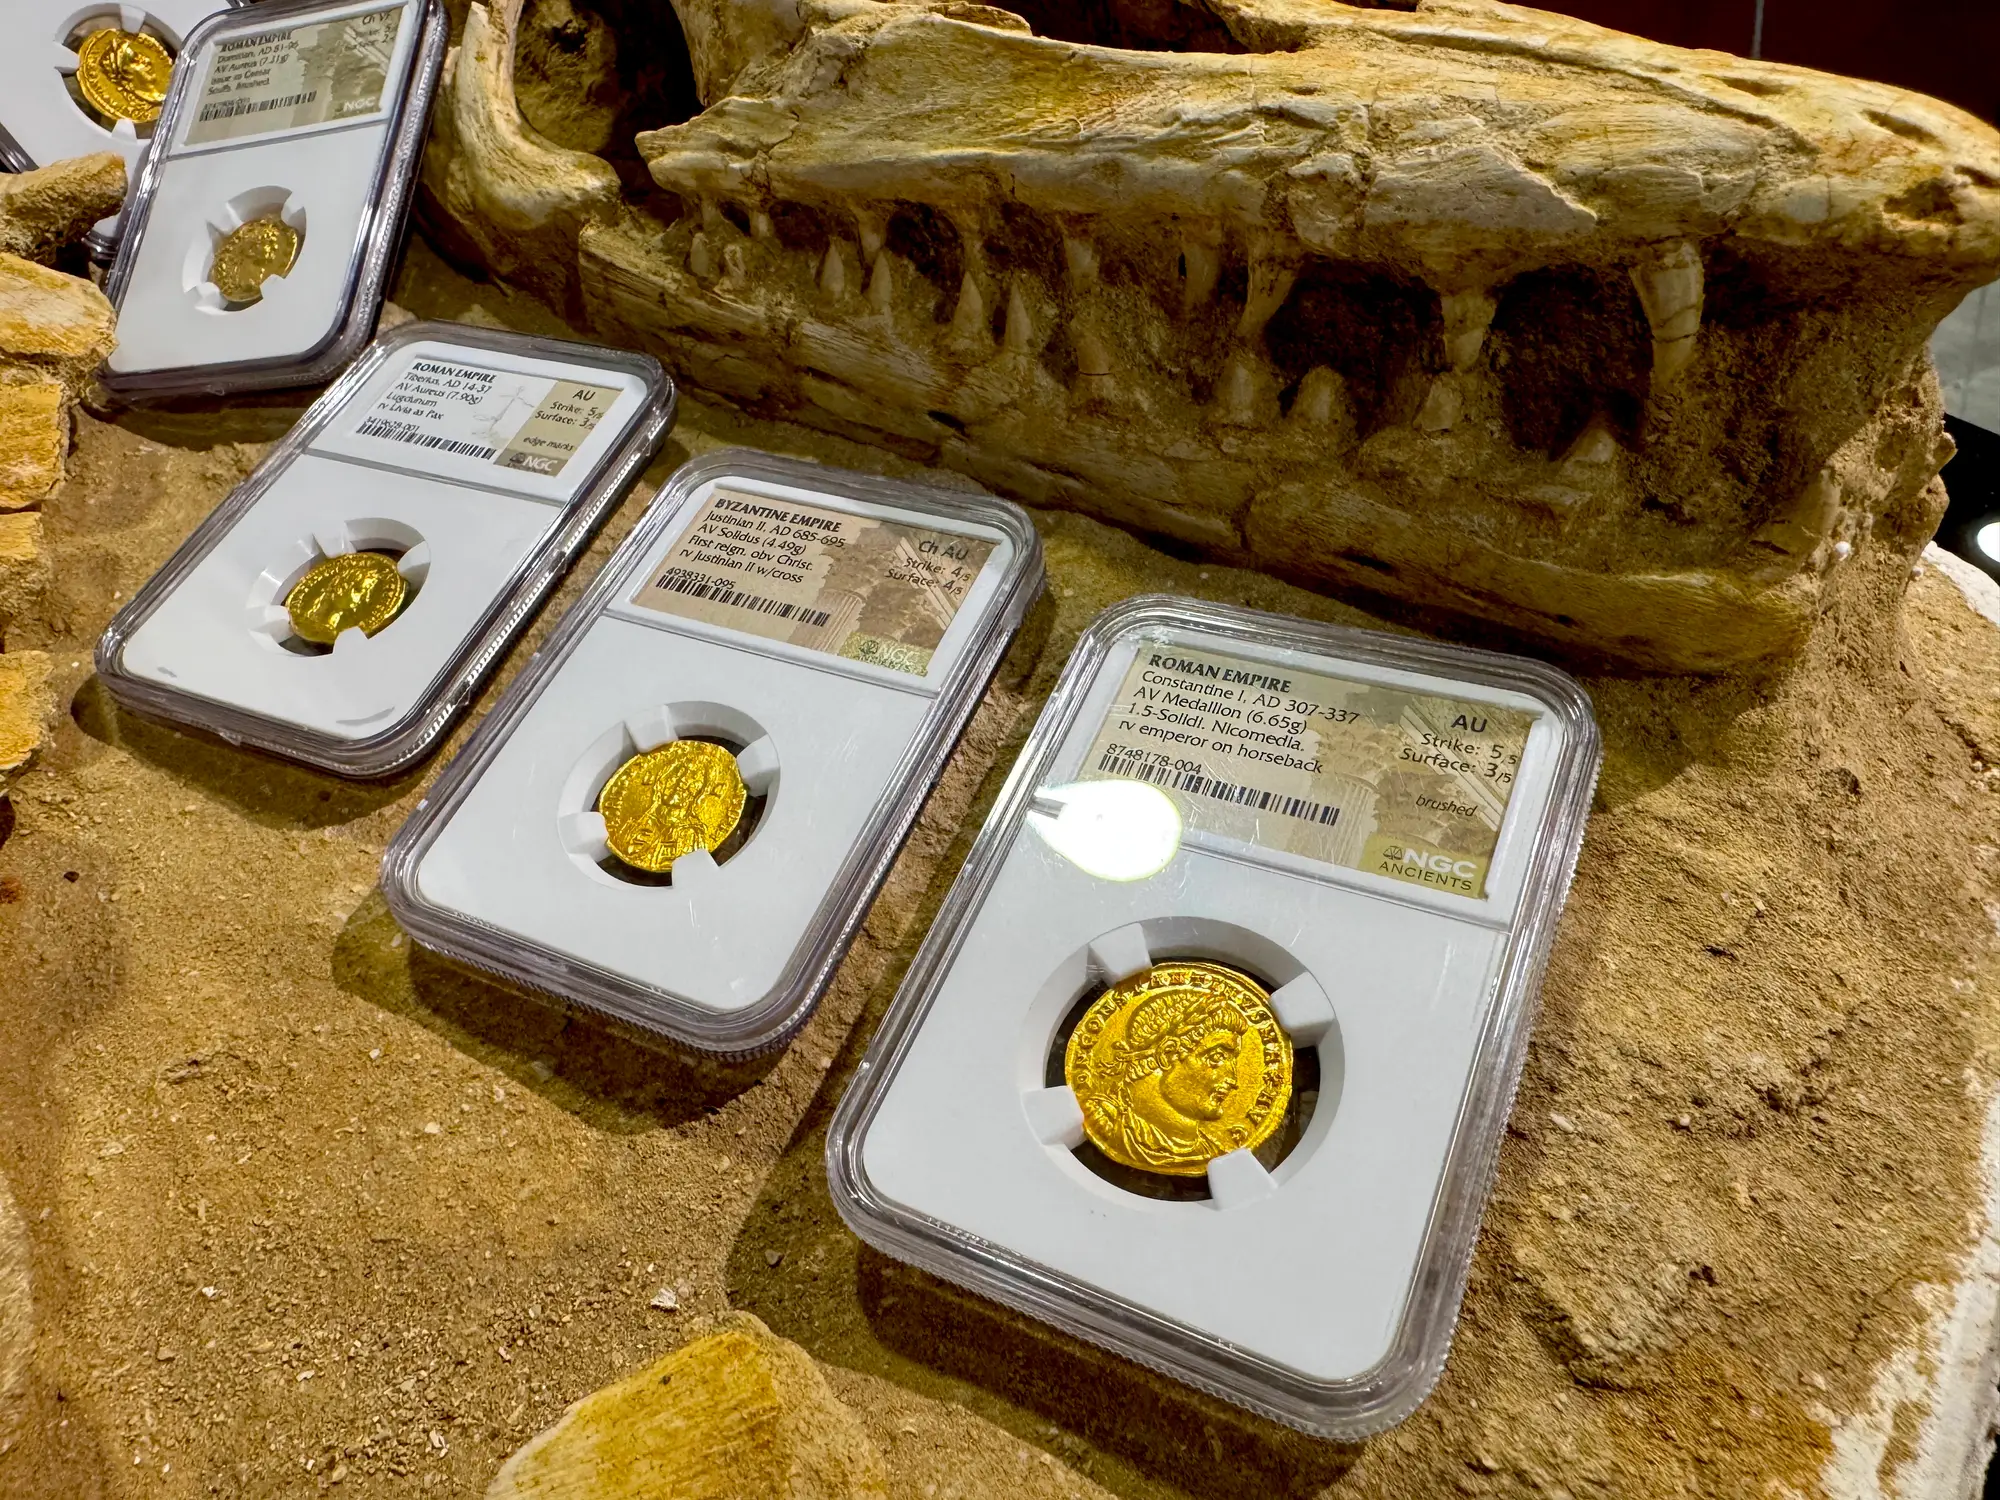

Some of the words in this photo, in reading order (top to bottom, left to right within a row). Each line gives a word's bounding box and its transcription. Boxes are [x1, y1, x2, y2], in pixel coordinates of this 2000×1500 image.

[343, 96, 376, 112] NGC
[412, 362, 456, 376] ROMAN
[454, 369, 497, 383] EMPIRE
[395, 382, 412, 391] AV
[412, 384, 445, 397] Aureus
[443, 379, 462, 388] AD
[462, 382, 492, 394] 14-37
[572, 389, 596, 401] AU
[535, 410, 577, 425] Surface:
[550, 401, 584, 414] Strike:
[523, 436, 547, 447] edge
[523, 456, 558, 472] NGC
[714, 499, 790, 523] BYZANTINE
[789, 514, 841, 532] EMPIRE
[697, 523, 717, 534] AV
[717, 527, 760, 545] Solidus
[761, 536, 807, 556] (4.49g)
[703, 511, 754, 530] Justinian
[769, 524, 791, 535] AD
[792, 529, 846, 548] 685-695
[750, 550, 775, 563] obv
[776, 554, 813, 571] Christ.
[918, 540, 939, 555] Ch
[941, 546, 969, 560] AU
[679, 549, 692, 557] rv
[692, 551, 743, 571] Justinian
[744, 561, 755, 572] II
[757, 565, 804, 584] w/cross
[903, 557, 945, 575] Strike:
[951, 566, 971, 582] 4/5
[884, 568, 937, 588] Surface:
[943, 581, 964, 595] 4/5
[1148, 654, 1221, 679] ROMAN
[1222, 669, 1292, 693] EMPIRE
[1133, 686, 1161, 701] AV
[1162, 693, 1242, 719] Medallion
[1246, 709, 1307, 735] (6.65g)
[1142, 671, 1233, 701] Constantine
[1253, 694, 1280, 709] AD
[1285, 700, 1360, 725] 307-337
[1212, 720, 1306, 752] Nicomedia.
[1451, 714, 1488, 733] AU
[1119, 720, 1135, 731] rv
[1139, 723, 1208, 749] emperor
[1211, 740, 1232, 754] on
[1237, 746, 1323, 774] horseback
[1421, 733, 1480, 755] Strike:
[1106, 743, 1202, 774] 8748178-004
[1400, 747, 1476, 772] Surface:
[1484, 762, 1512, 784] 3/5
[1416, 795, 1479, 817] brushed
[1403, 848, 1477, 878] NGC
[1379, 861, 1472, 891] ANCIENTS
